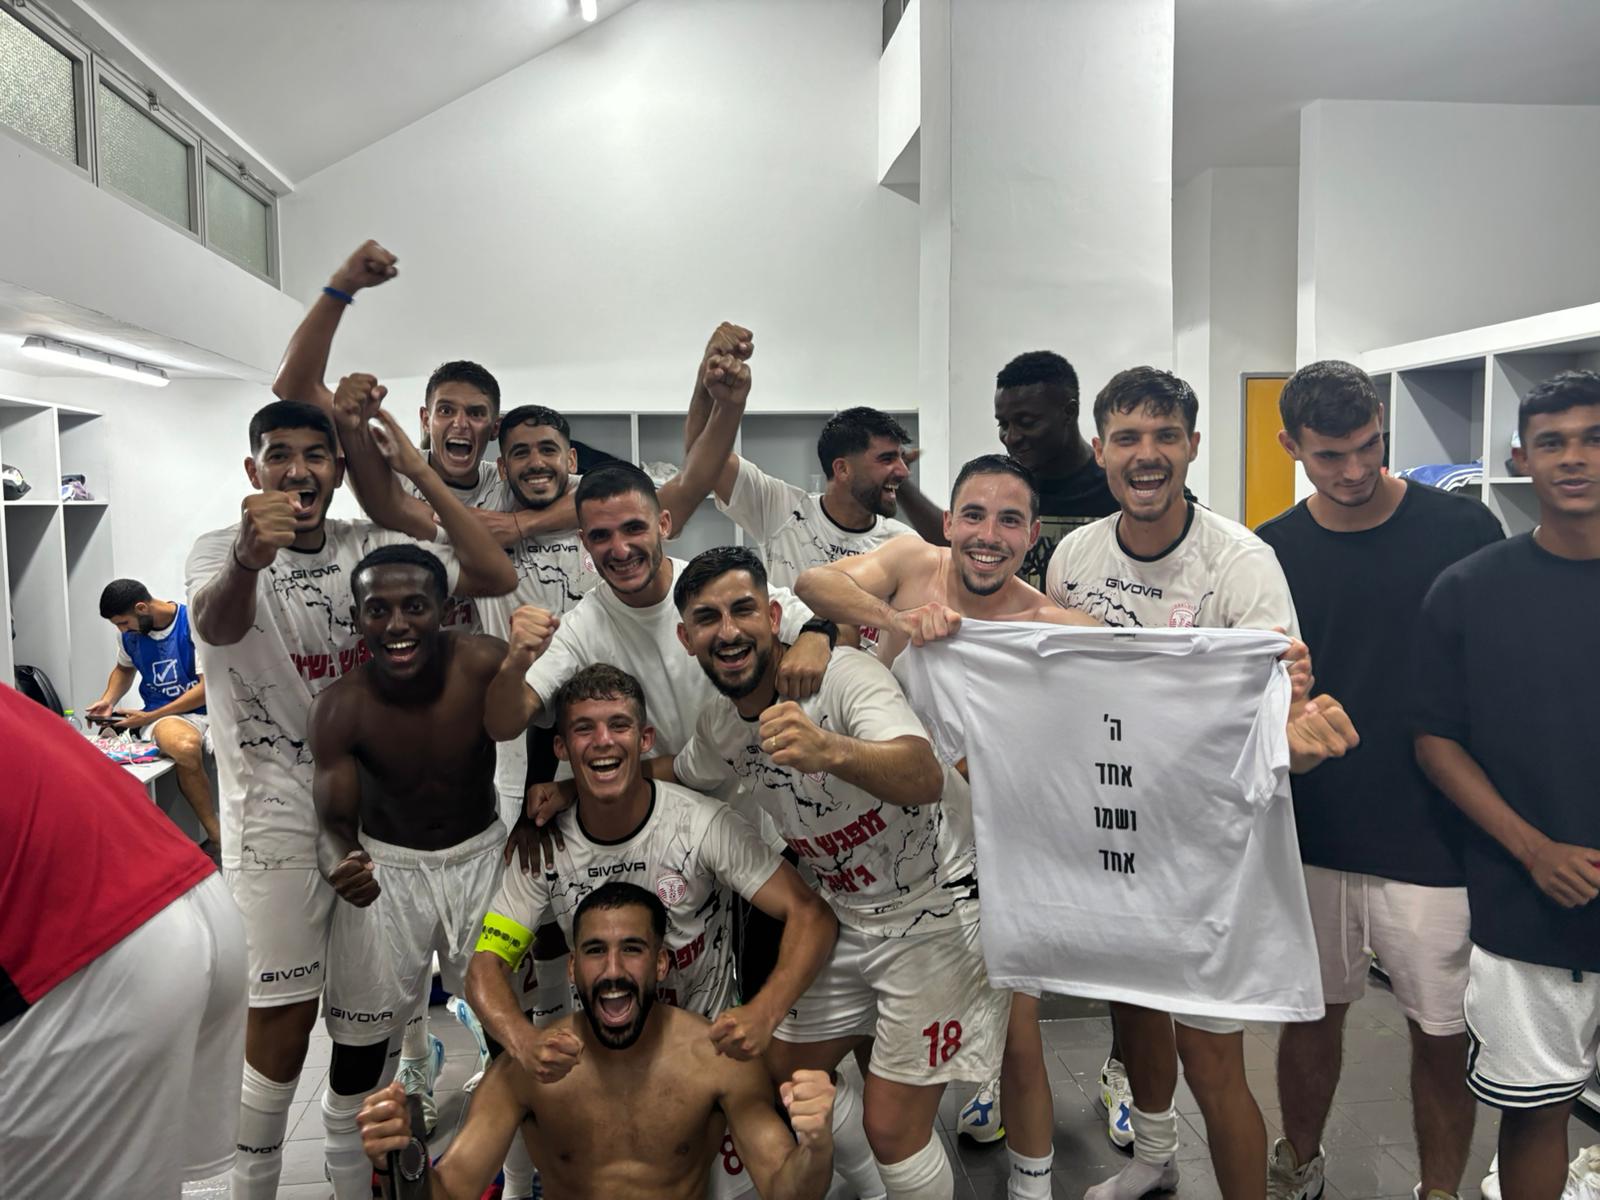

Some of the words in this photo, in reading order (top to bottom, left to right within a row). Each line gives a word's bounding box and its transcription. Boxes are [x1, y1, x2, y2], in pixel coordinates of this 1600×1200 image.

[528, 544, 578, 553] GIVOVA
[1106, 578, 1162, 599] GIVOVA
[1103, 713, 1122, 741] ה'
[1095, 762, 1133, 787] אחד
[1094, 806, 1137, 832] ושמו
[588, 862, 646, 878] GIVOVA
[1099, 849, 1136, 874] אחד
[261, 961, 320, 983] GIVOVA
[331, 1007, 393, 1023] GIVOVA
[923, 1020, 962, 1067] 18
